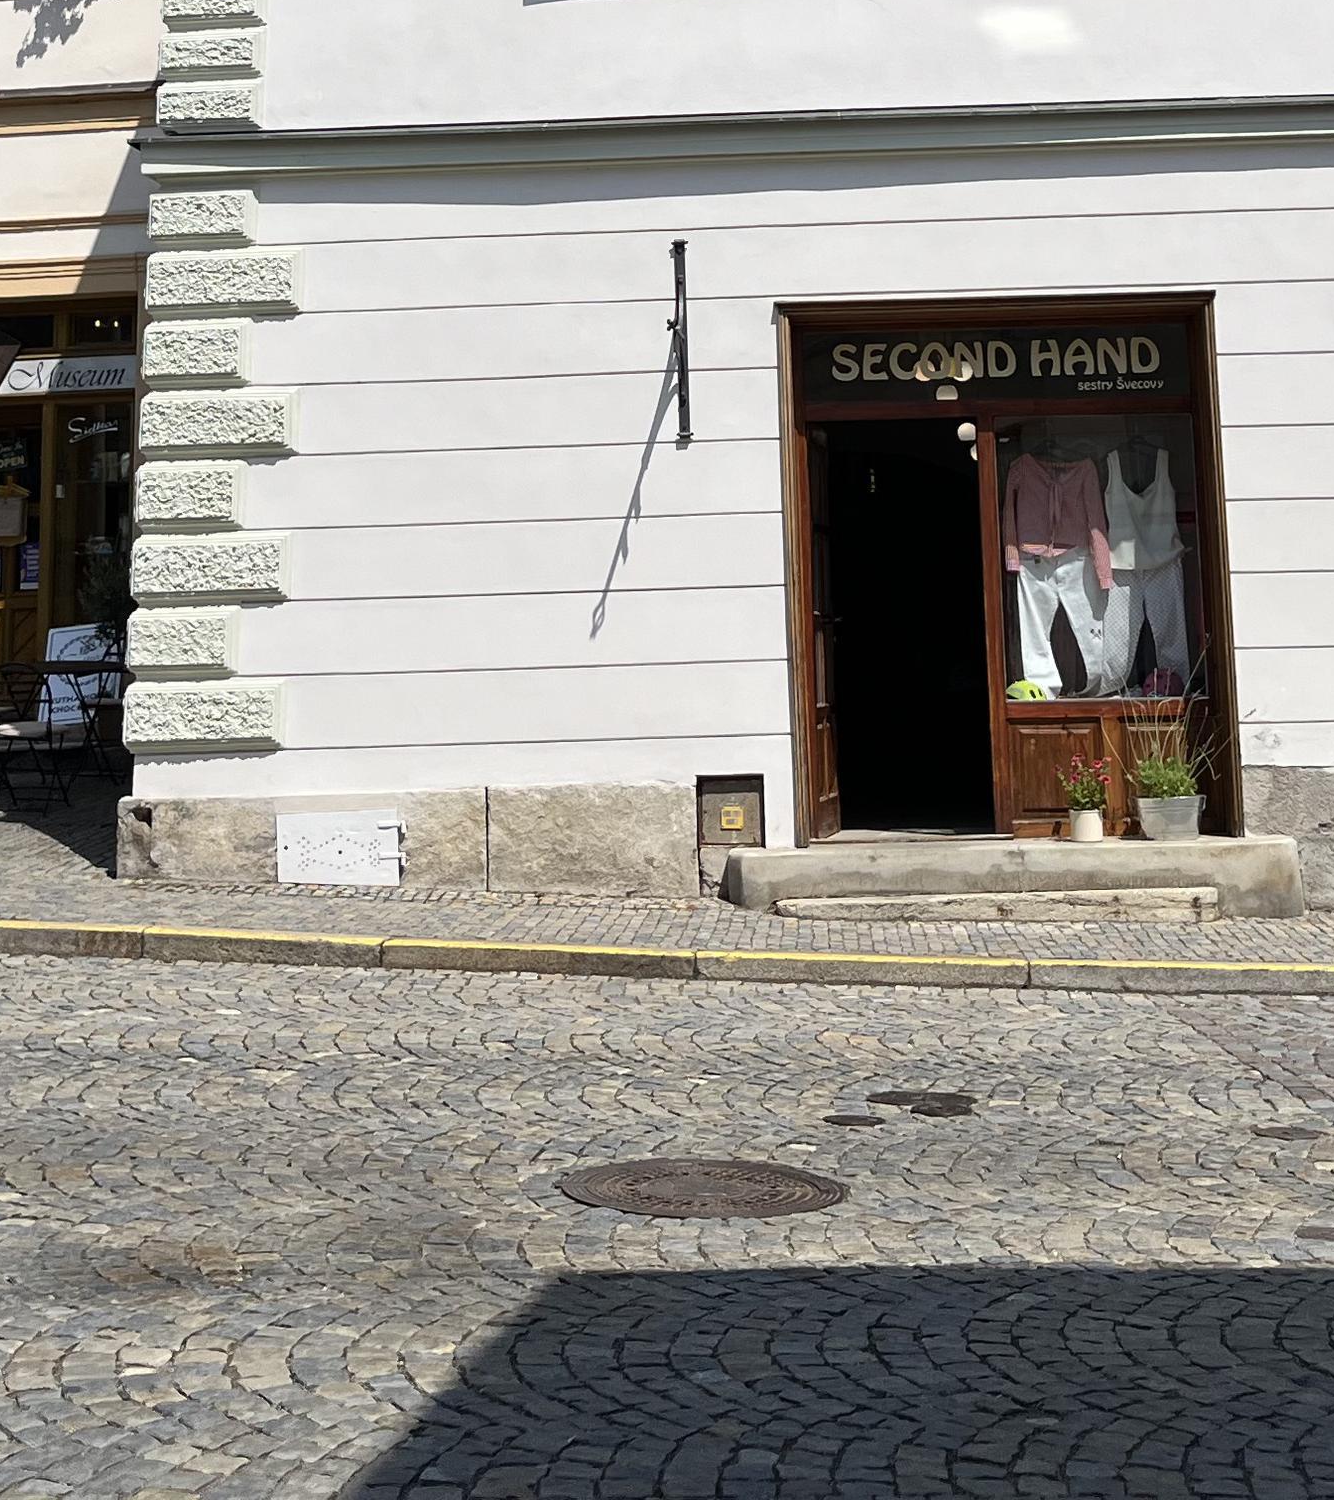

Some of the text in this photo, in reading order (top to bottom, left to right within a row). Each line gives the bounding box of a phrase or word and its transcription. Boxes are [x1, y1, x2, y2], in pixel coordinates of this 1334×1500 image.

[831, 337, 1160, 382] SECOND HAND
[8, 361, 126, 391] Museum
[1078, 377, 1164, 392] sestry Švecovy
